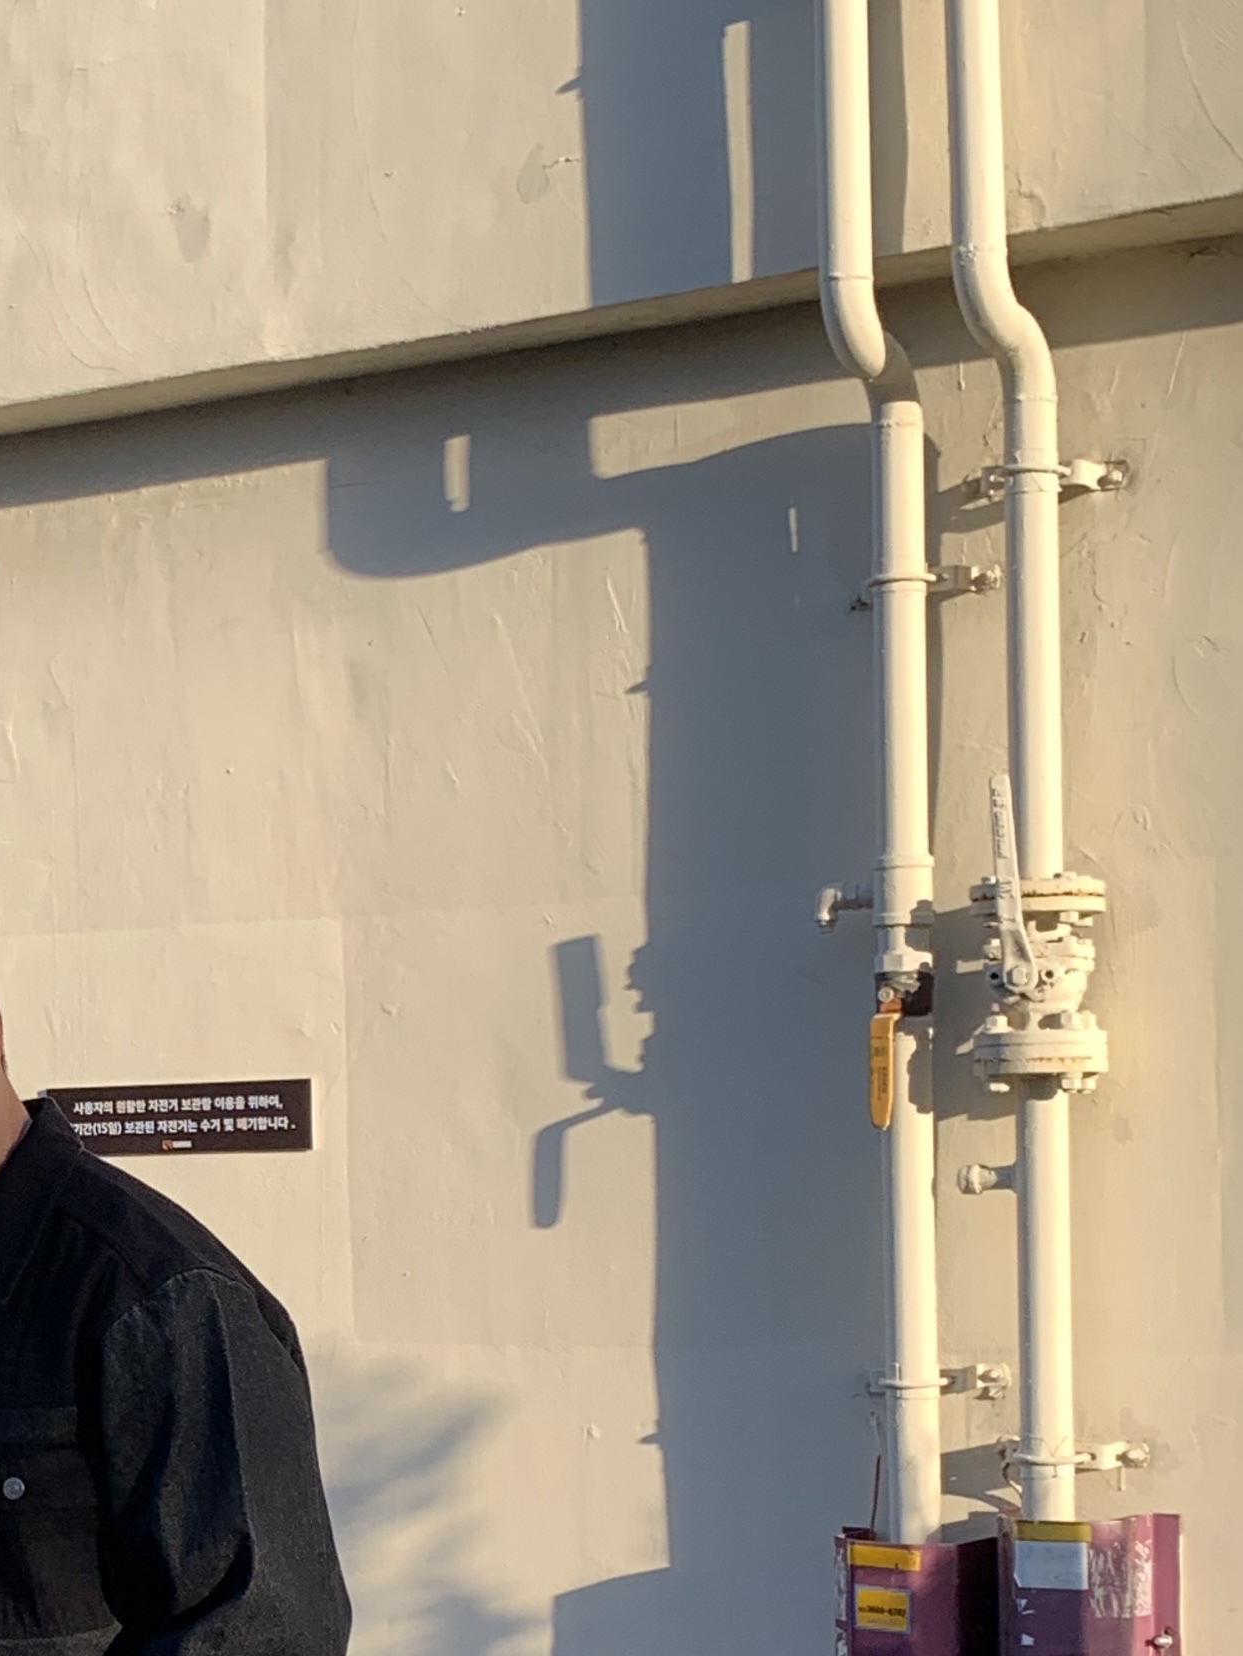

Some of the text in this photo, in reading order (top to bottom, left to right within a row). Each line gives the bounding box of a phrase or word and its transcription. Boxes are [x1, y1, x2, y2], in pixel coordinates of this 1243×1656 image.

[73, 1101, 114, 1115] 사용자의
[116, 1099, 146, 1114] 원활한
[148, 1098, 179, 1113] 자전거
[214, 1096, 245, 1110] 이용을
[70, 1121, 122, 1136] 기간(15일)
[125, 1121, 155, 1134] 보관된
[157, 1119, 198, 1134] 자전거는
[200, 1118, 221, 1132] 수거
[223, 1118, 235, 1131] 및
